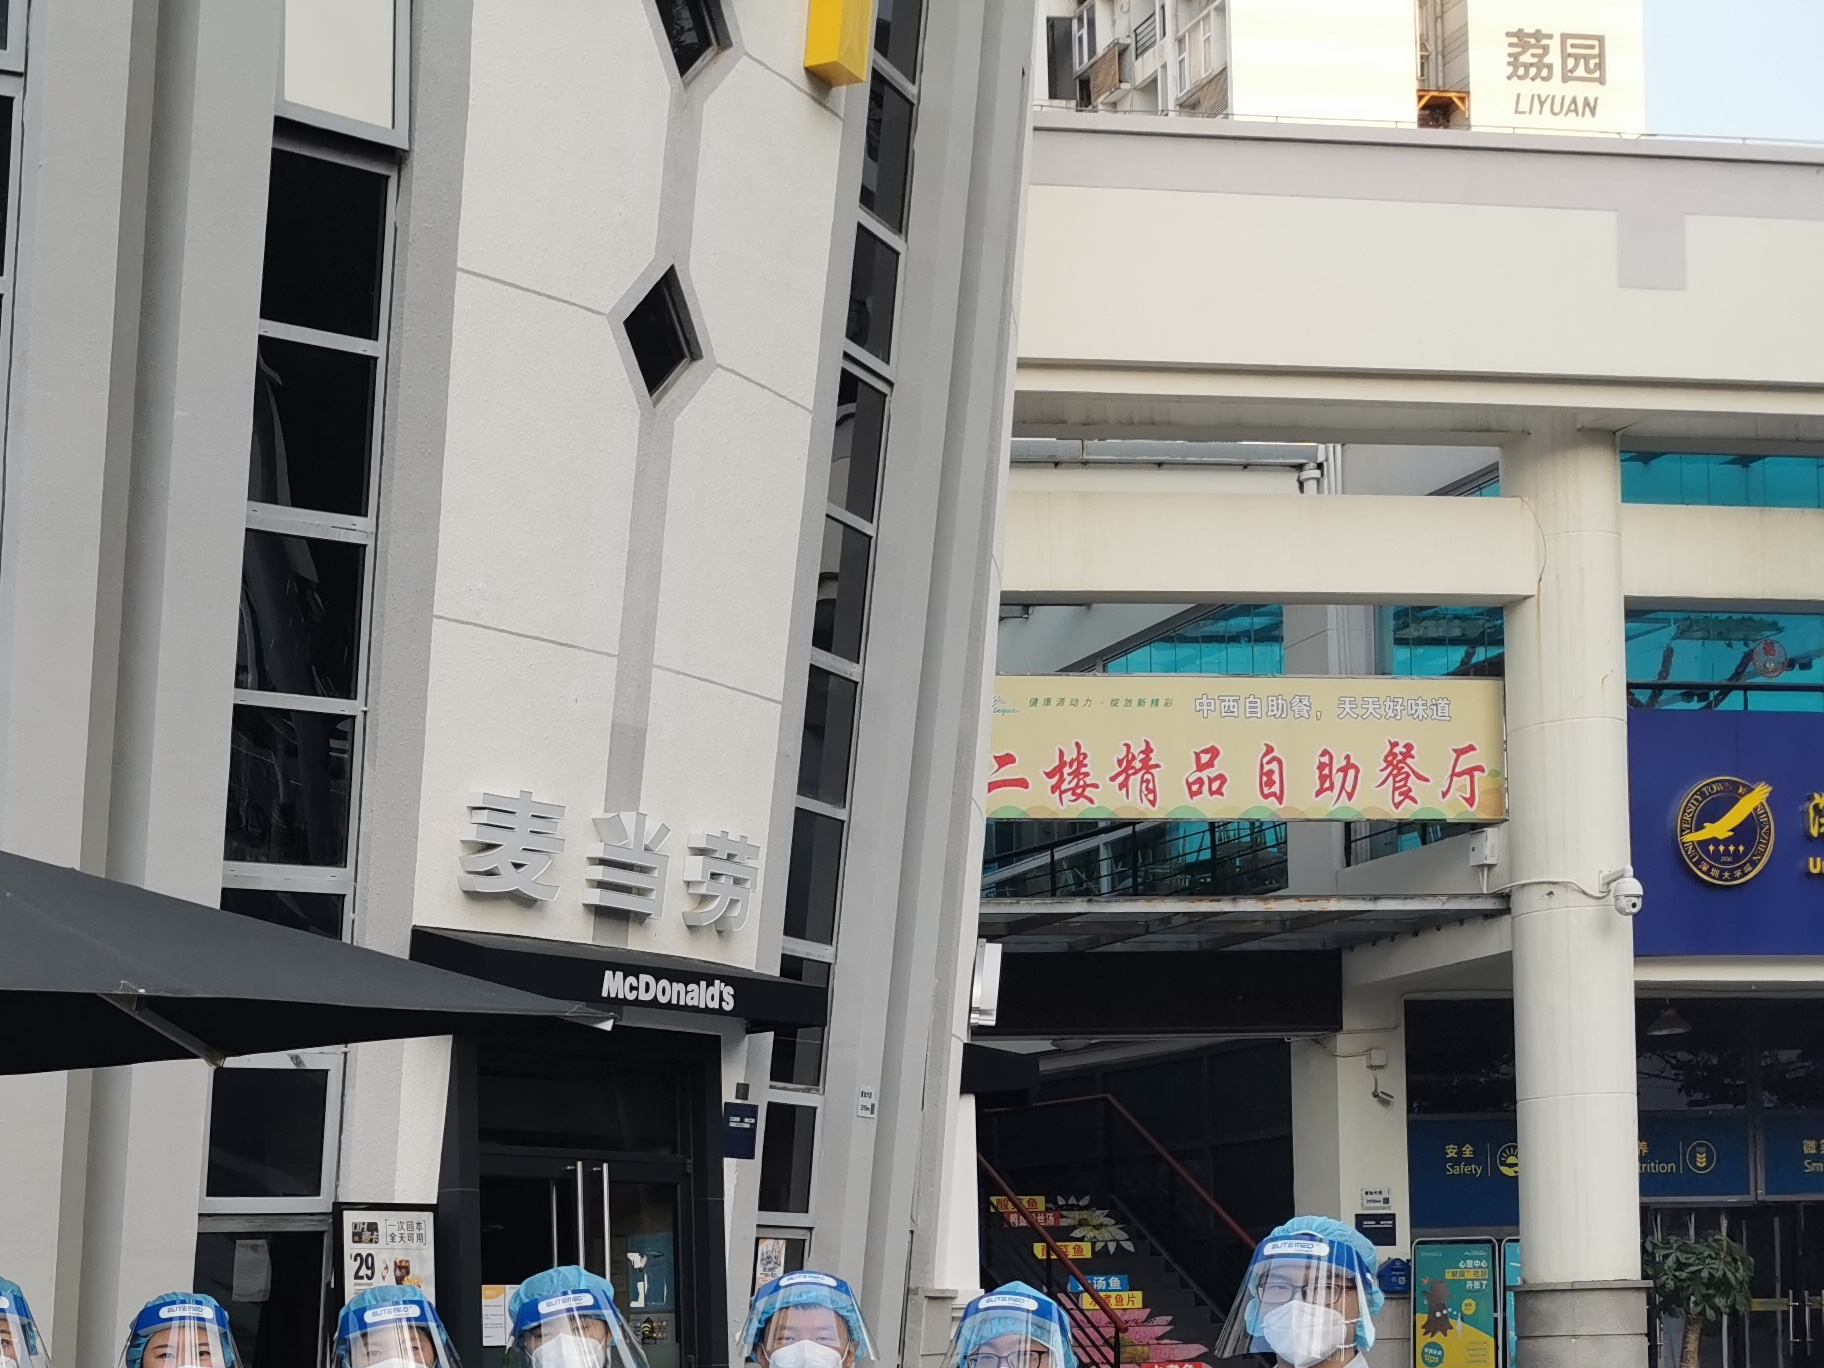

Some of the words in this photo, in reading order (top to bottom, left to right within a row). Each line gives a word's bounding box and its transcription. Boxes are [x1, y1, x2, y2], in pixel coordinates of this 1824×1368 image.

[1504, 27, 1607, 87] 荔园
[1513, 92, 1599, 119] LIYUAN
[987, 738, 1487, 810] 二楼精品自助餐厅
[457, 790, 761, 932] 麦当劳
[601, 970, 735, 1011] McDonald's
[1445, 1143, 1474, 1159] 安全
[1446, 1161, 1483, 1177] Safety
[996, 1198, 1038, 1210] 酸鱼
[1078, 1276, 1122, 1290] 汤鱼
